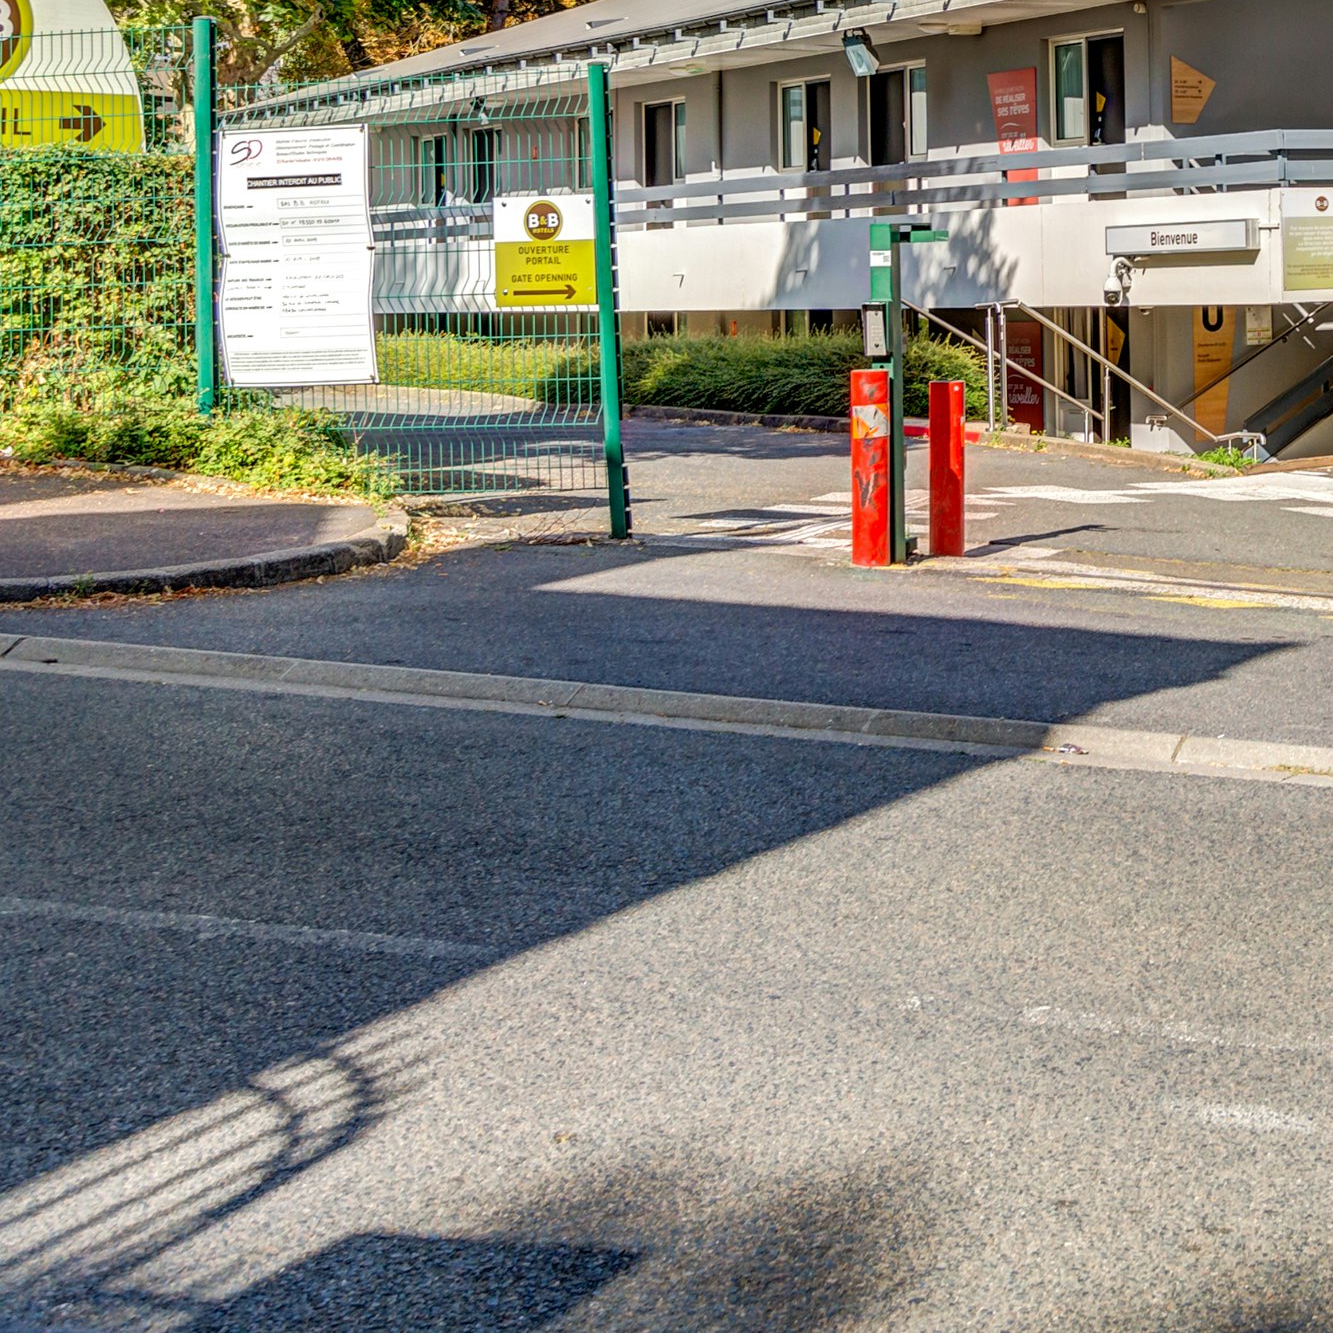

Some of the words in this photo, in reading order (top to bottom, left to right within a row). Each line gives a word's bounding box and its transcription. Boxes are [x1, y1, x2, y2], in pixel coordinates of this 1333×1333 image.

[247, 179, 277, 188] CHANTIER
[278, 177, 307, 186] INTERDIT
[307, 176, 317, 185] AU
[318, 175, 342, 184] PUBLIC
[528, 213, 559, 228] B&B
[1151, 231, 1198, 246] Bienvenue
[518, 245, 570, 255] OUVERTURE
[526, 256, 561, 265] PORTAIL
[511, 274, 533, 283] GATE
[535, 273, 578, 282] OPENNING
